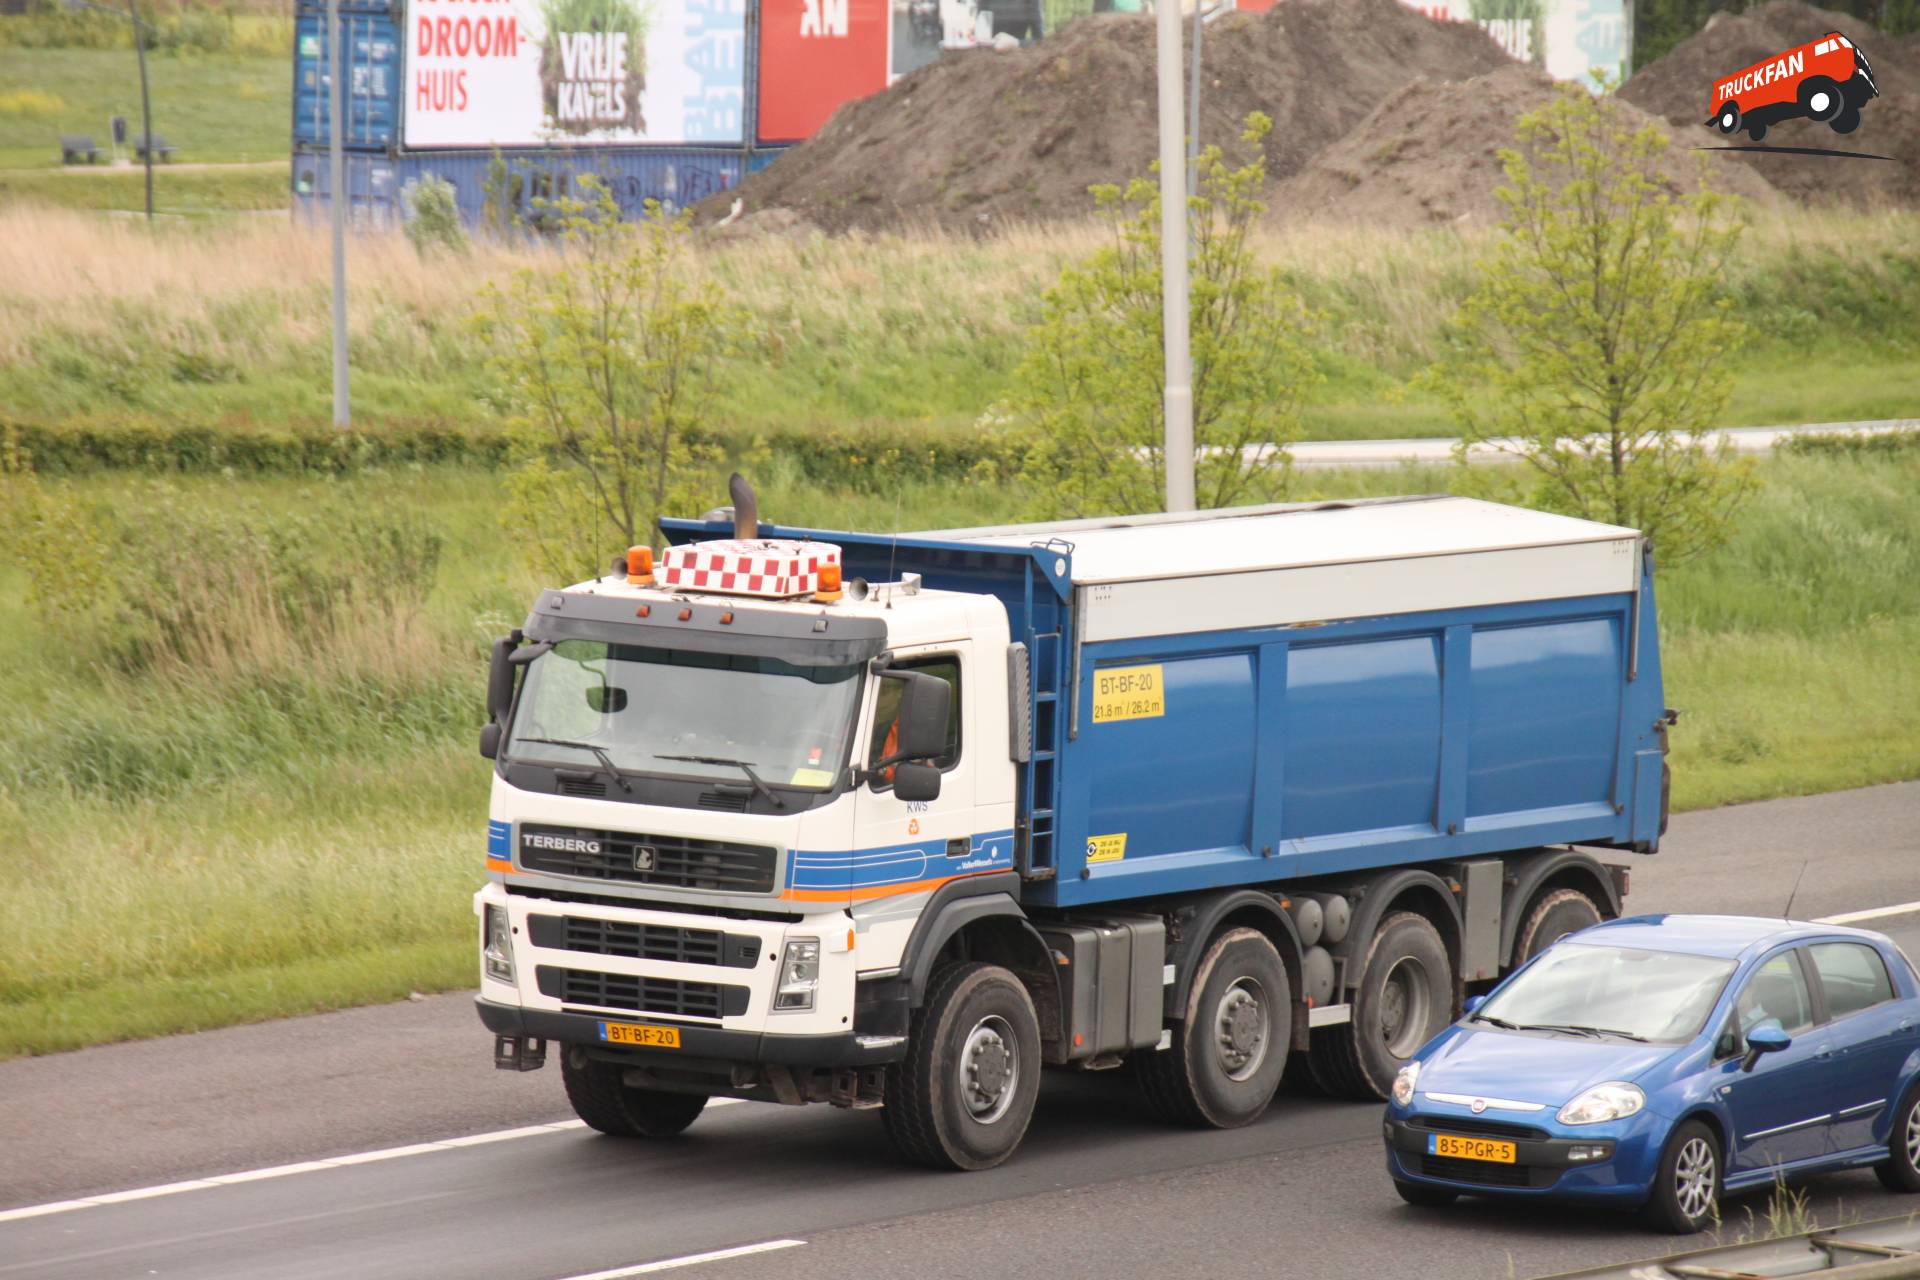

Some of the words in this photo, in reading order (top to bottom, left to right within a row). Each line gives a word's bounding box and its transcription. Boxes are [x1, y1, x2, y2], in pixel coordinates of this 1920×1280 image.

[417, 15, 527, 57] DROOM-
[559, 31, 627, 81] VRIJE
[416, 68, 468, 112] HUIS
[558, 81, 627, 120] KAVELS
[1100, 673, 1153, 695] BT-BF-20
[1131, 699, 1150, 714] 26.2
[907, 800, 929, 813] KWS
[522, 834, 600, 854] TERBERG
[611, 1026, 674, 1045] BT-BF-20
[1440, 1138, 1510, 1159] 85-PGR-5
